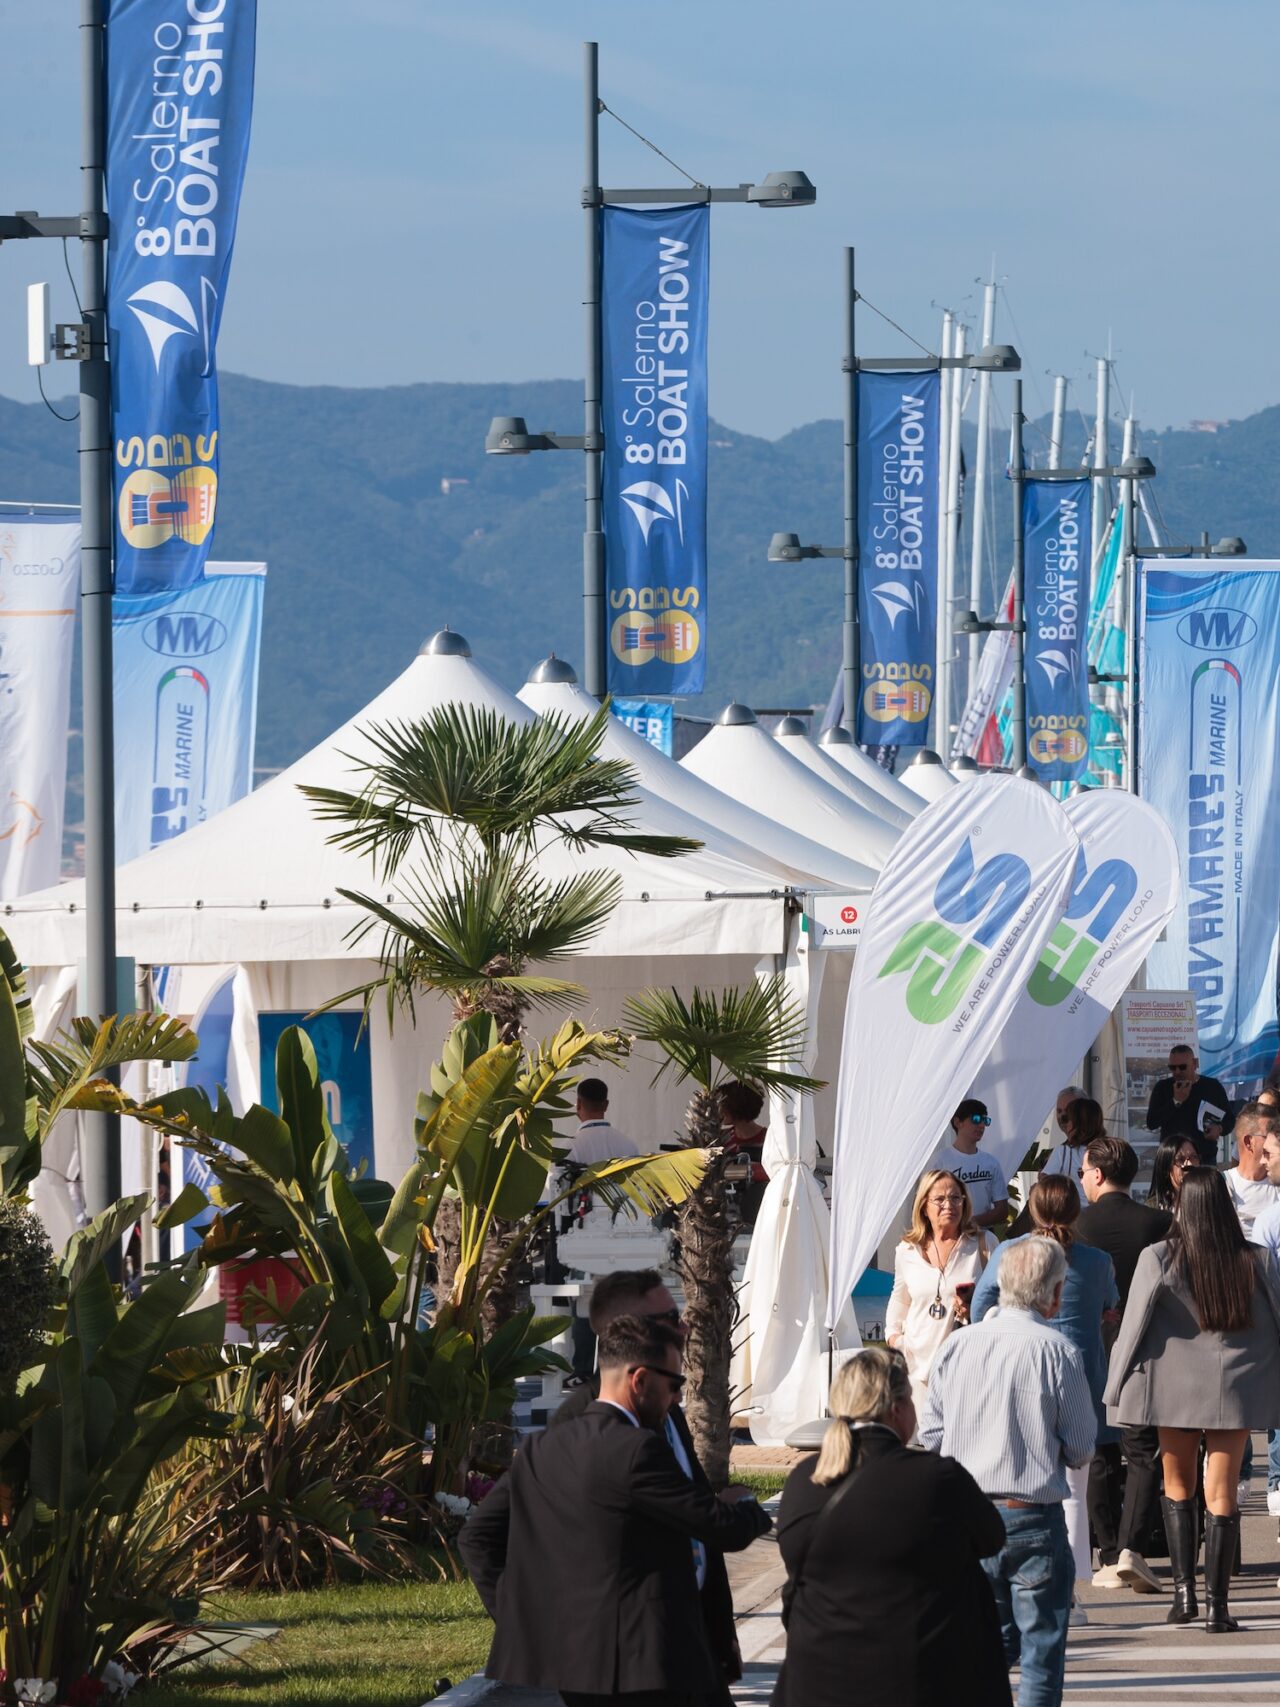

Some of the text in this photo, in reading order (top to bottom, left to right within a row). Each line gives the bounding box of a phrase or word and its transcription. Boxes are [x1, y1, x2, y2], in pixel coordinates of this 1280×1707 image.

[132, 22, 182, 204] Salerno
[174, 0, 226, 257] BOAT SHO
[621, 300, 655, 428] Salerno
[657, 236, 690, 466] BOAT SHOW
[872, 443, 899, 541] Salerno
[899, 394, 926, 571] BOAT SHOW
[1036, 537, 1059, 616] Salerno
[1058, 499, 1080, 641] BOAT SHOW
[175, 702, 194, 779] MARINE
[1188, 693, 1227, 1030] NOVAMARES MARINE
[1233, 789, 1245, 894] MADE IN ITALY
[843, 910, 855, 920] 12
[952, 885, 1047, 1033] WE ARE POWER LOAD
[1067, 889, 1154, 1015] WE ARE POWER LOAD
[953, 1164, 993, 1181] Jordan
